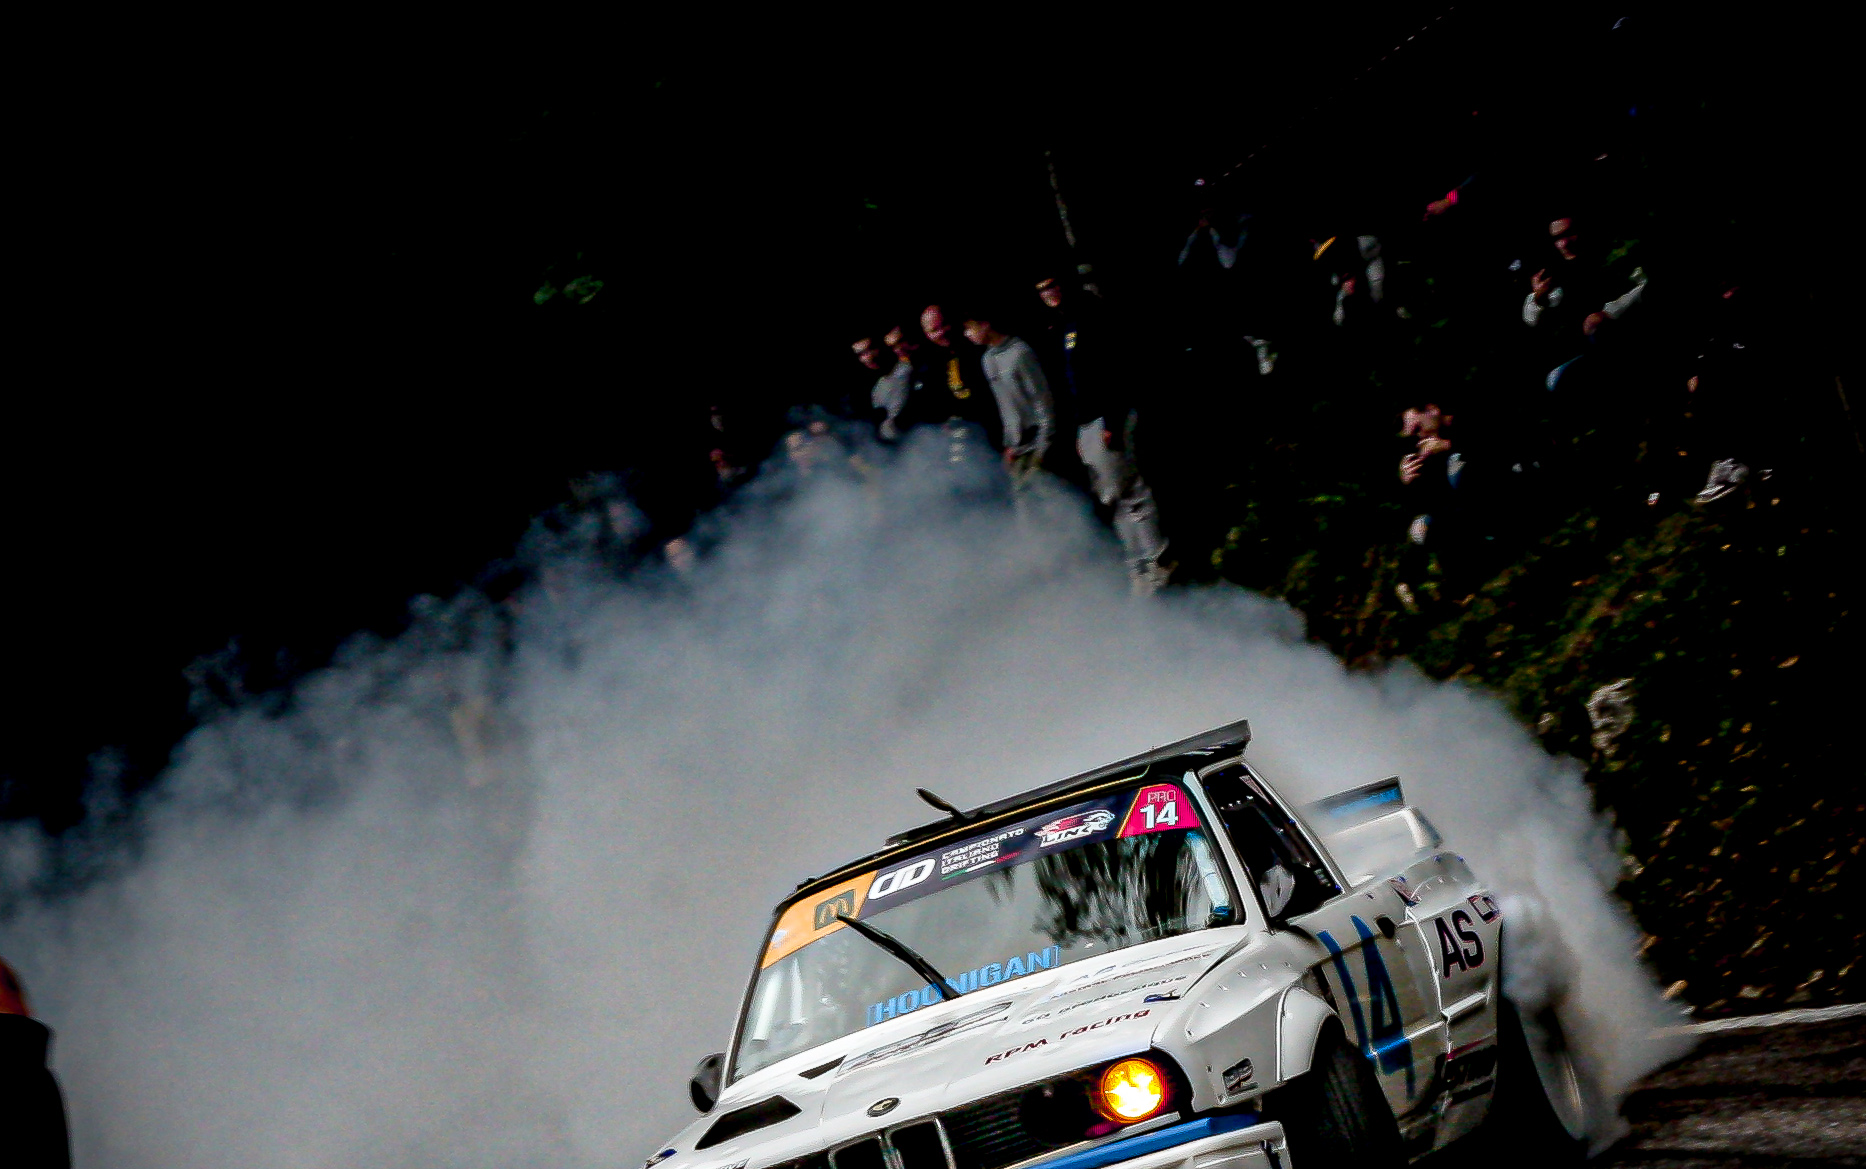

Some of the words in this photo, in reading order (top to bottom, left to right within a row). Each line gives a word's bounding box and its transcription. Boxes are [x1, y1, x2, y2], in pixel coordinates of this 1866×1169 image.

[1140, 801, 1178, 830] 14
[984, 1037, 1048, 1066] RPM
[1058, 1008, 1151, 1040] racing
